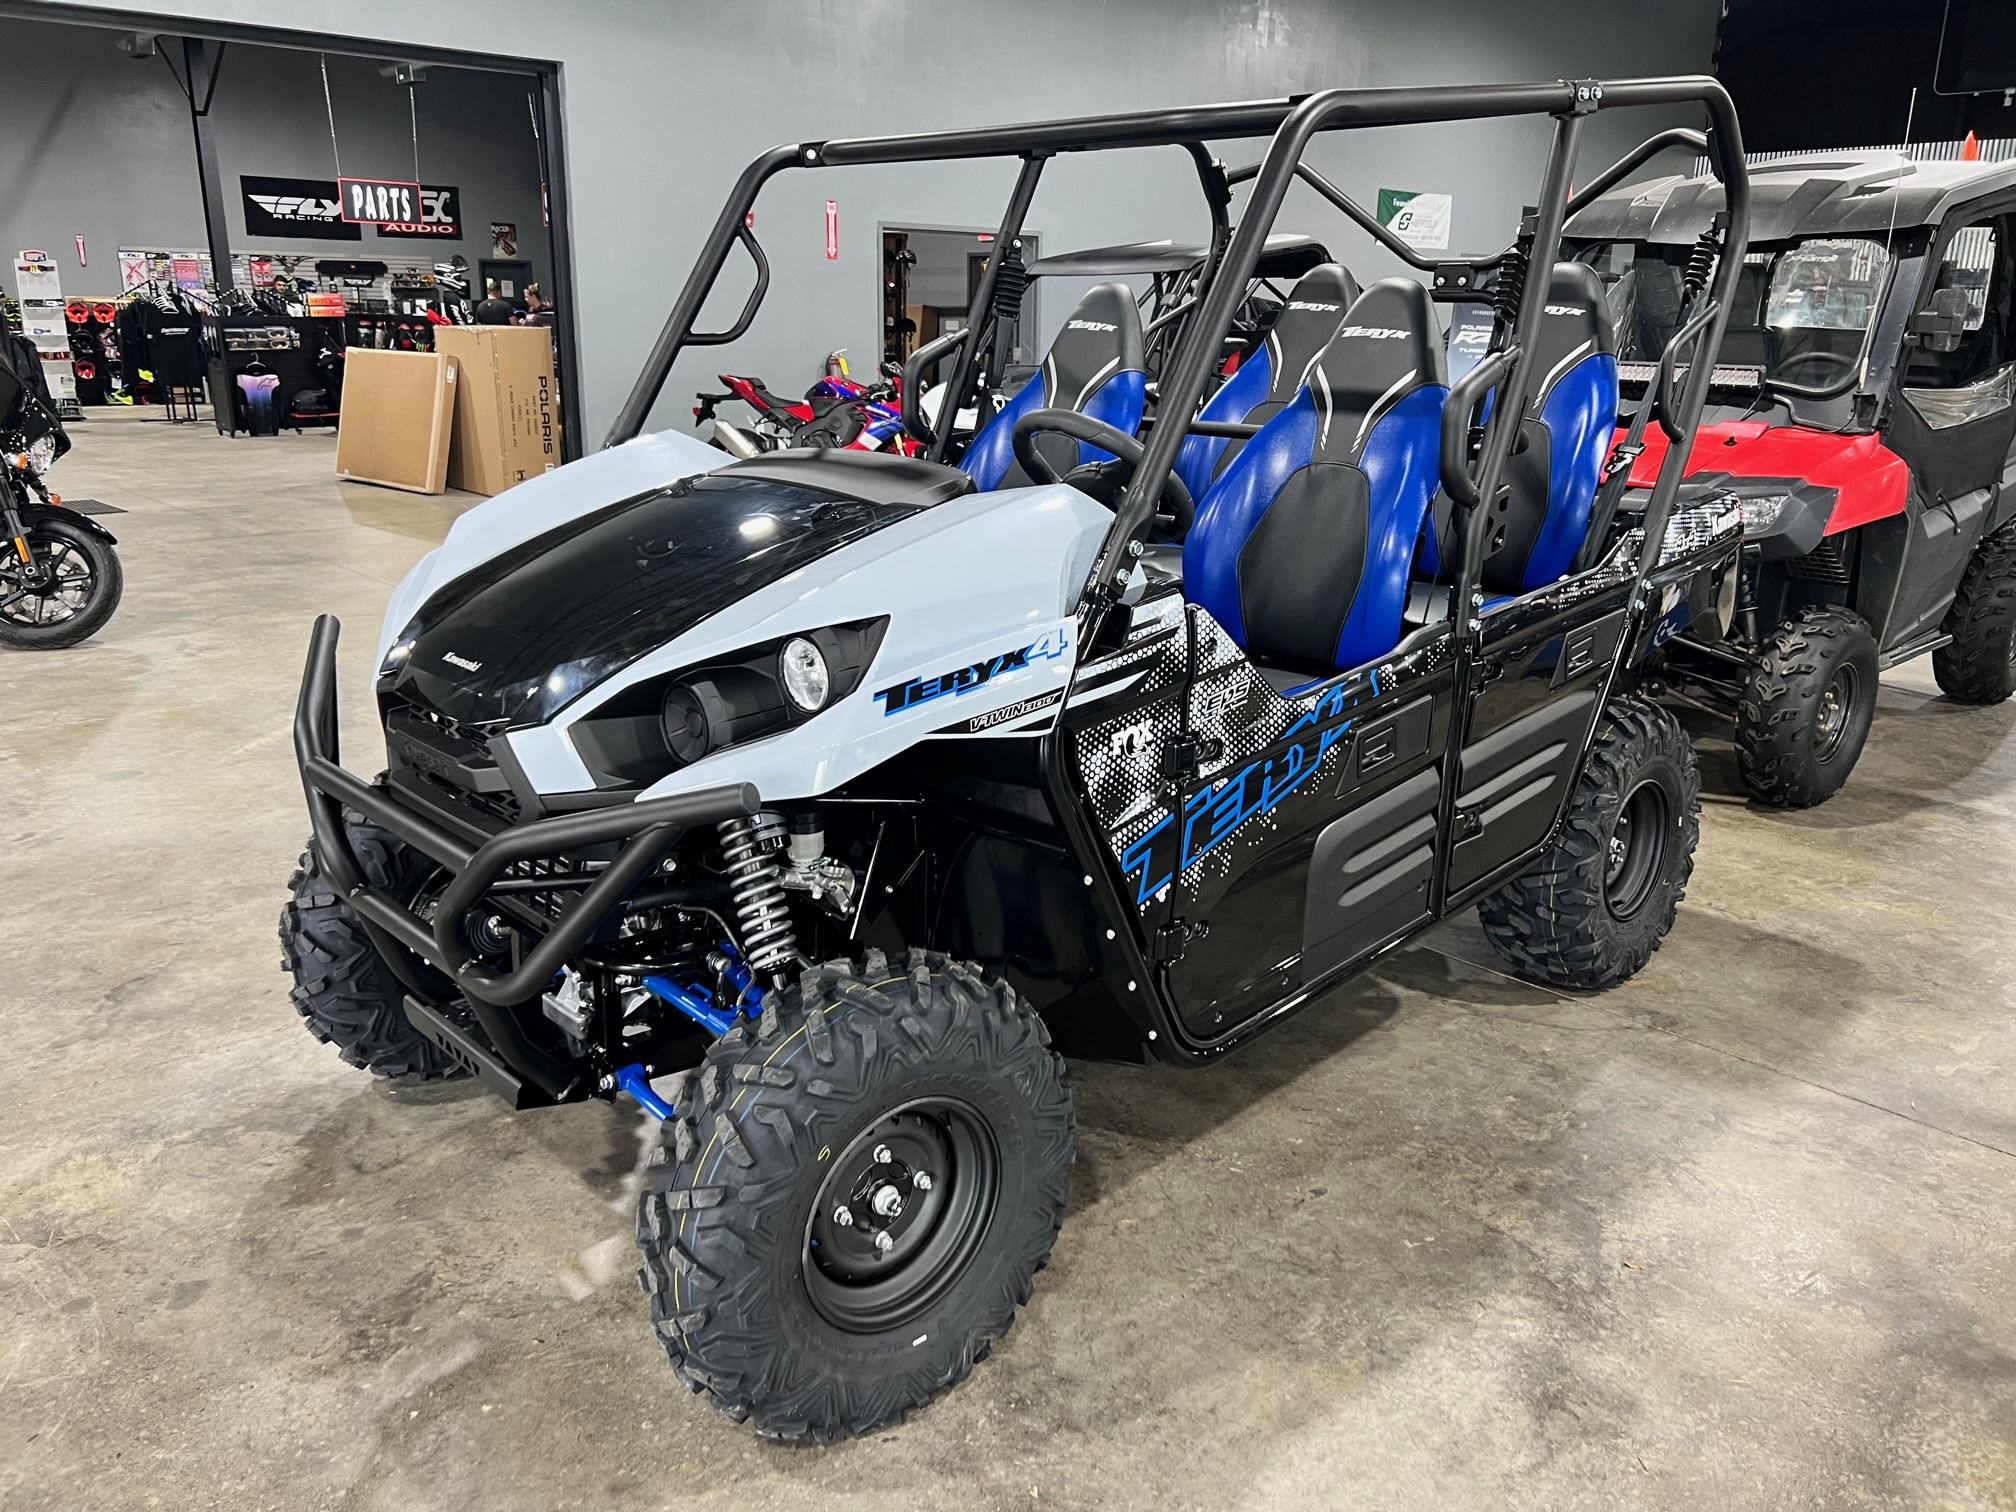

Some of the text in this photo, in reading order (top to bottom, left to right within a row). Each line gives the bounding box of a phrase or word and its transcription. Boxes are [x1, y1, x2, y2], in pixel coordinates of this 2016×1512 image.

[352, 184, 411, 221] PARTS
[273, 214, 333, 222] RACING
[385, 224, 453, 233] AUDIO
[1288, 301, 1340, 312] TERYX
[1068, 319, 1118, 332] TERYX
[1341, 326, 1412, 339] TERYX
[1453, 331, 1492, 344] RZ
[538, 376, 553, 455] POLARIS
[442, 651, 483, 672] Kawasaki
[1204, 680, 1250, 715] EPS
[1111, 718, 1154, 759] FOX
